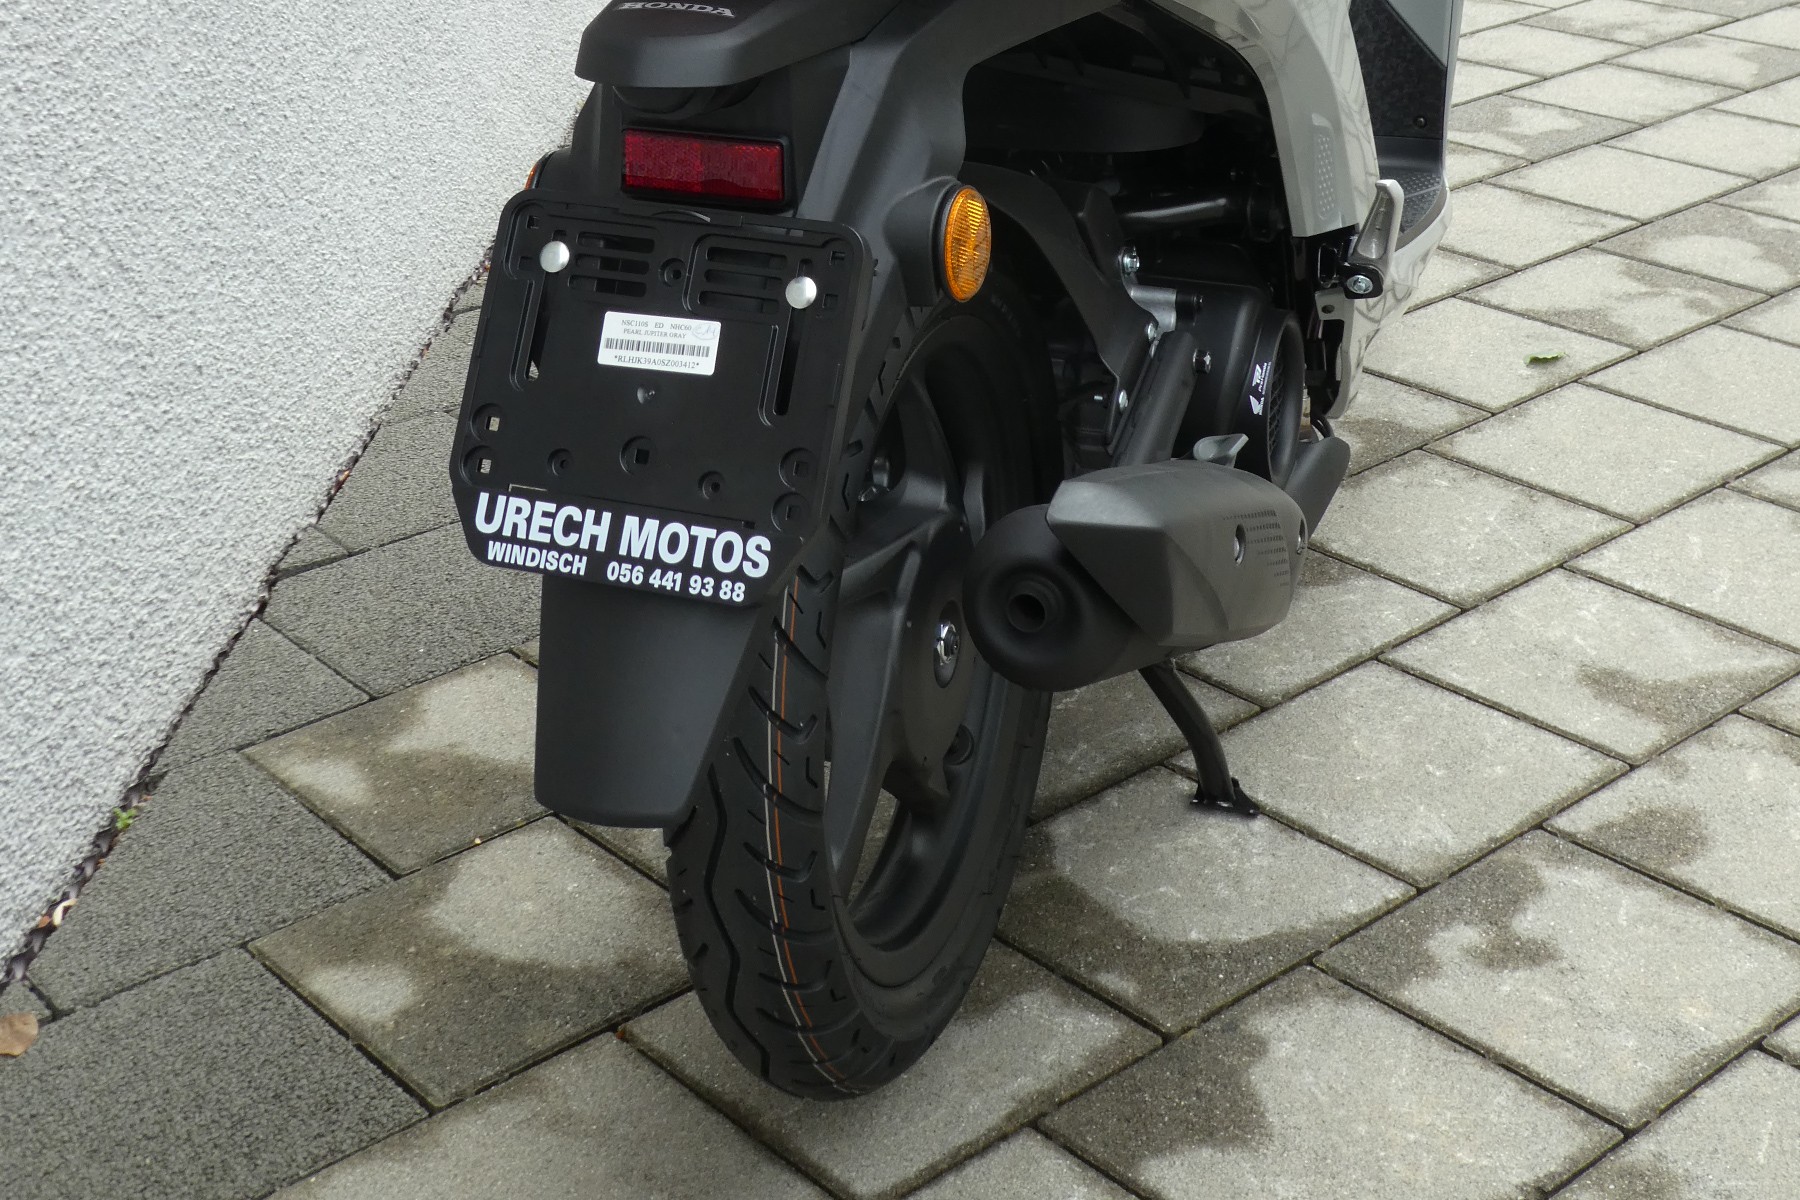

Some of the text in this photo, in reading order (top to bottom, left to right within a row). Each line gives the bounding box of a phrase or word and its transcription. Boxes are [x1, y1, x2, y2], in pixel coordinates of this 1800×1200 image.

[618, 2, 736, 18] HONDA
[623, 328, 642, 336] PEARL
[654, 321, 664, 329] ED
[475, 492, 771, 578] URECH MOTOS
[487, 540, 746, 602] WINDISCH 056 441 93 88
